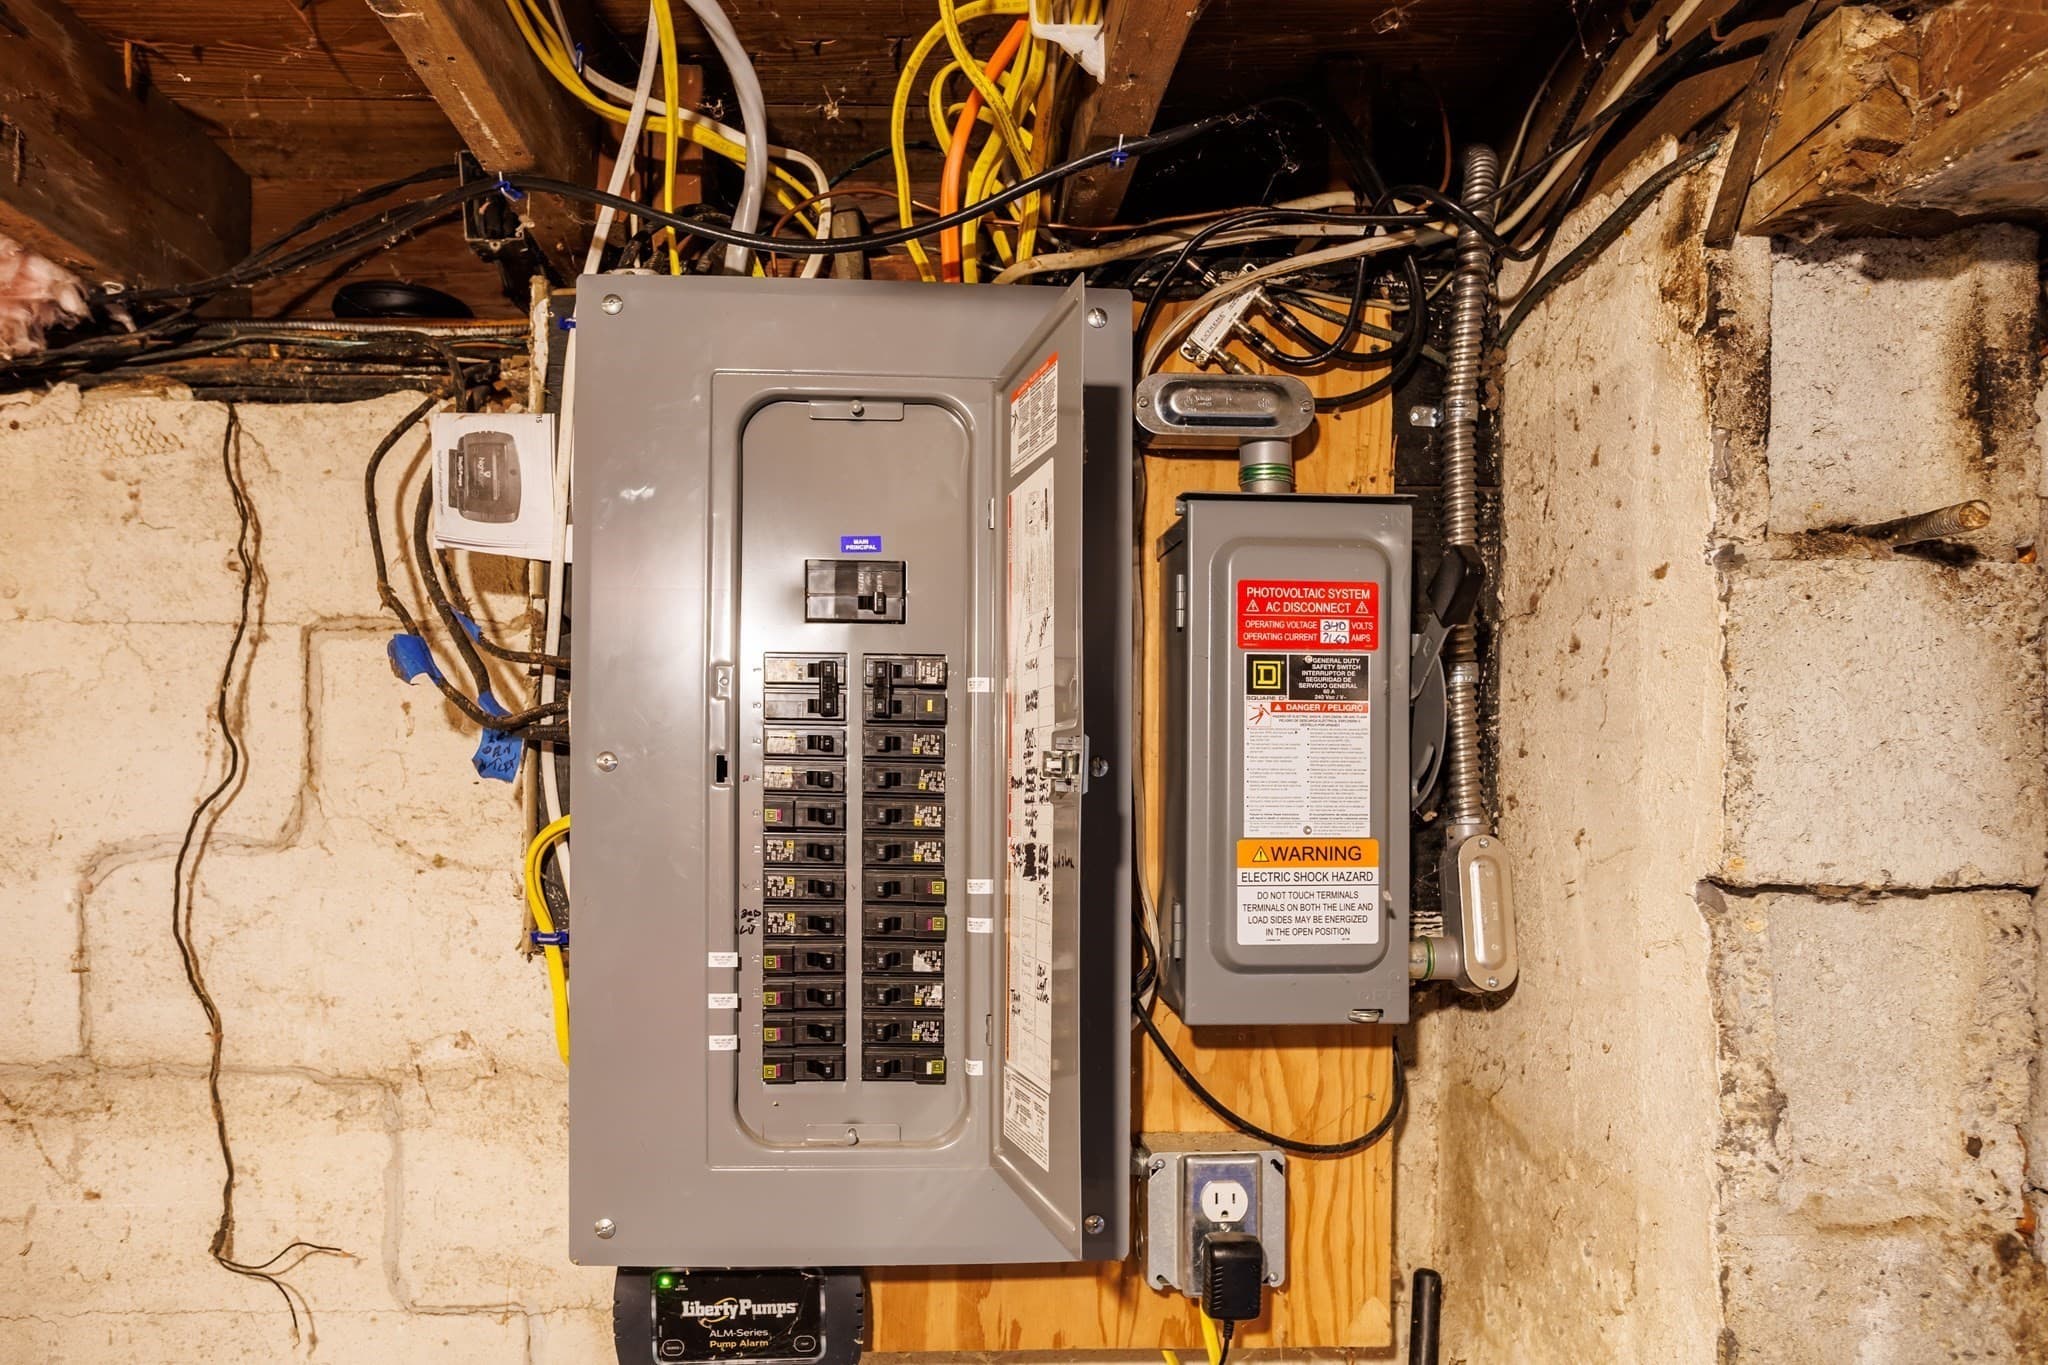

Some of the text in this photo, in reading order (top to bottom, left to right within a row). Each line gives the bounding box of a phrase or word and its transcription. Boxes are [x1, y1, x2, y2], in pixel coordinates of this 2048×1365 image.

[1246, 587, 1370, 599] PHOTOVOLTAIC SYSTEM
[1265, 602, 1351, 613] AC DISCONNECT
[1245, 620, 1374, 632] OPERATING VOLTAGE 240 VOLTS
[1243, 632, 1282, 641] OPERATING
[1284, 633, 1317, 641] CURRENT
[1351, 634, 1371, 642] AMPS
[1286, 703, 1320, 711] DANGER
[1328, 703, 1363, 711] PELIGRO
[1271, 846, 1361, 861] WARNING
[1241, 872, 1374, 882] ELECTRIC SHOCK HAZARD
[1316, 891, 1359, 899] TERMINALS
[1242, 904, 1285, 912] TERMINALS
[1300, 903, 1320, 911] BOTH
[1323, 903, 1338, 911] THE
[1339, 903, 1355, 911] LINE
[1357, 903, 1373, 911] AND
[1248, 915, 1368, 924] LOAD SIDES MAY BE ENERGIZED
[1265, 927, 1351, 936] IN THE OPEN POSITION
[681, 1299, 797, 1320] Liberty Pumps
[709, 1328, 769, 1338] ALM-Series
[709, 1339, 769, 1349] Pump Alarm
